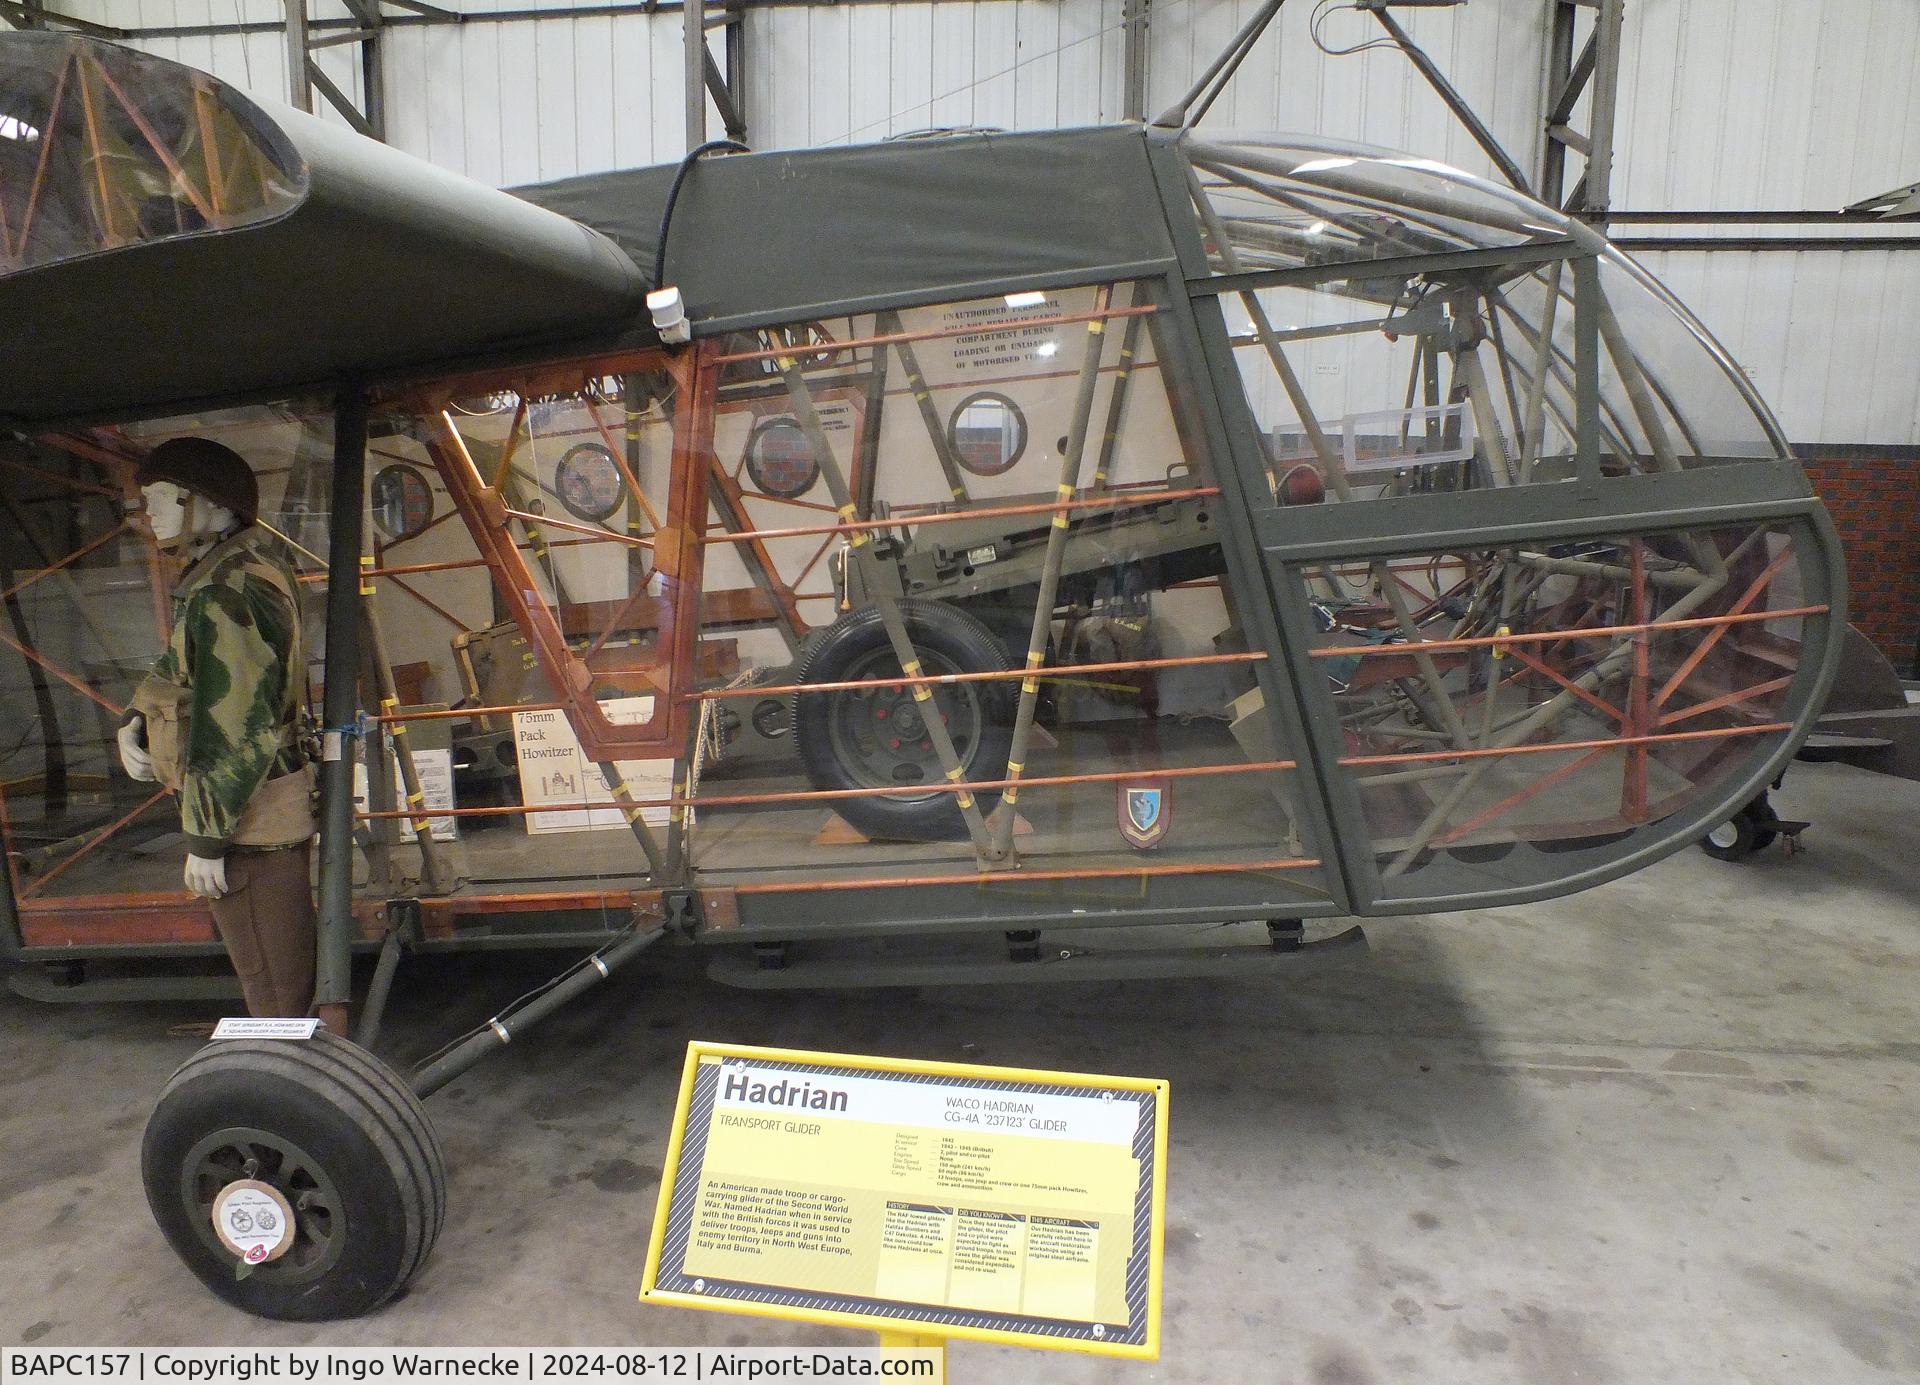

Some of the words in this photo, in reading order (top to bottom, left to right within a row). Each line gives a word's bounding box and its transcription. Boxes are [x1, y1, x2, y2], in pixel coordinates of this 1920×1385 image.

[944, 306, 1007, 320] UNAUTHORISED
[956, 331, 1017, 344] COMPARTMENT
[1023, 327, 1054, 336] DURING
[954, 347, 989, 358] LOADING
[974, 356, 1020, 367] MOTORISED
[518, 712, 555, 724] 75mm
[520, 730, 546, 741] Pack
[522, 747, 573, 760] Howitzer
[725, 1075, 847, 1110] Hadrian
[946, 1097, 980, 1109] WACO
[984, 1100, 1033, 1114] HADRIAN
[721, 1115, 781, 1130] TRANSPORT
[784, 1122, 821, 1135] GLIDER
[944, 1111, 979, 1124] CG-4A
[984, 1114, 1025, 1127] '237123'
[1029, 1118, 1066, 1131] GLIDER
[720, 1182, 758, 1192] American
[785, 1190, 807, 1200] troop
[820, 1195, 846, 1203] cargo-
[706, 1192, 738, 1202] carrying
[740, 1194, 763, 1203] glider
[776, 1198, 789, 1206] the
[791, 1200, 822, 1210] Second
[824, 1203, 848, 1213] World
[704, 1200, 722, 1208] War.
[724, 1202, 753, 1212] Named
[755, 1206, 786, 1216] Hadrian
[789, 1210, 811, 1219] when
[823, 1215, 852, 1224] service
[722, 1212, 734, 1220] the
[737, 1214, 763, 1223] British
[766, 1217, 790, 1227] forces
[700, 1220, 728, 1229] deliver
[730, 1223, 758, 1234] troops,
[760, 1226, 783, 1237] Jeeps
[825, 1234, 842, 1243] into
[696, 1239, 714, 1249] Italy
[734, 1244, 762, 1254] Burma.
[698, 1231, 726, 1241] enemy
[728, 1233, 760, 1245] territory
[772, 1238, 795, 1248] North
[798, 1241, 818, 1250] West
[820, 1244, 852, 1256] Europe,
